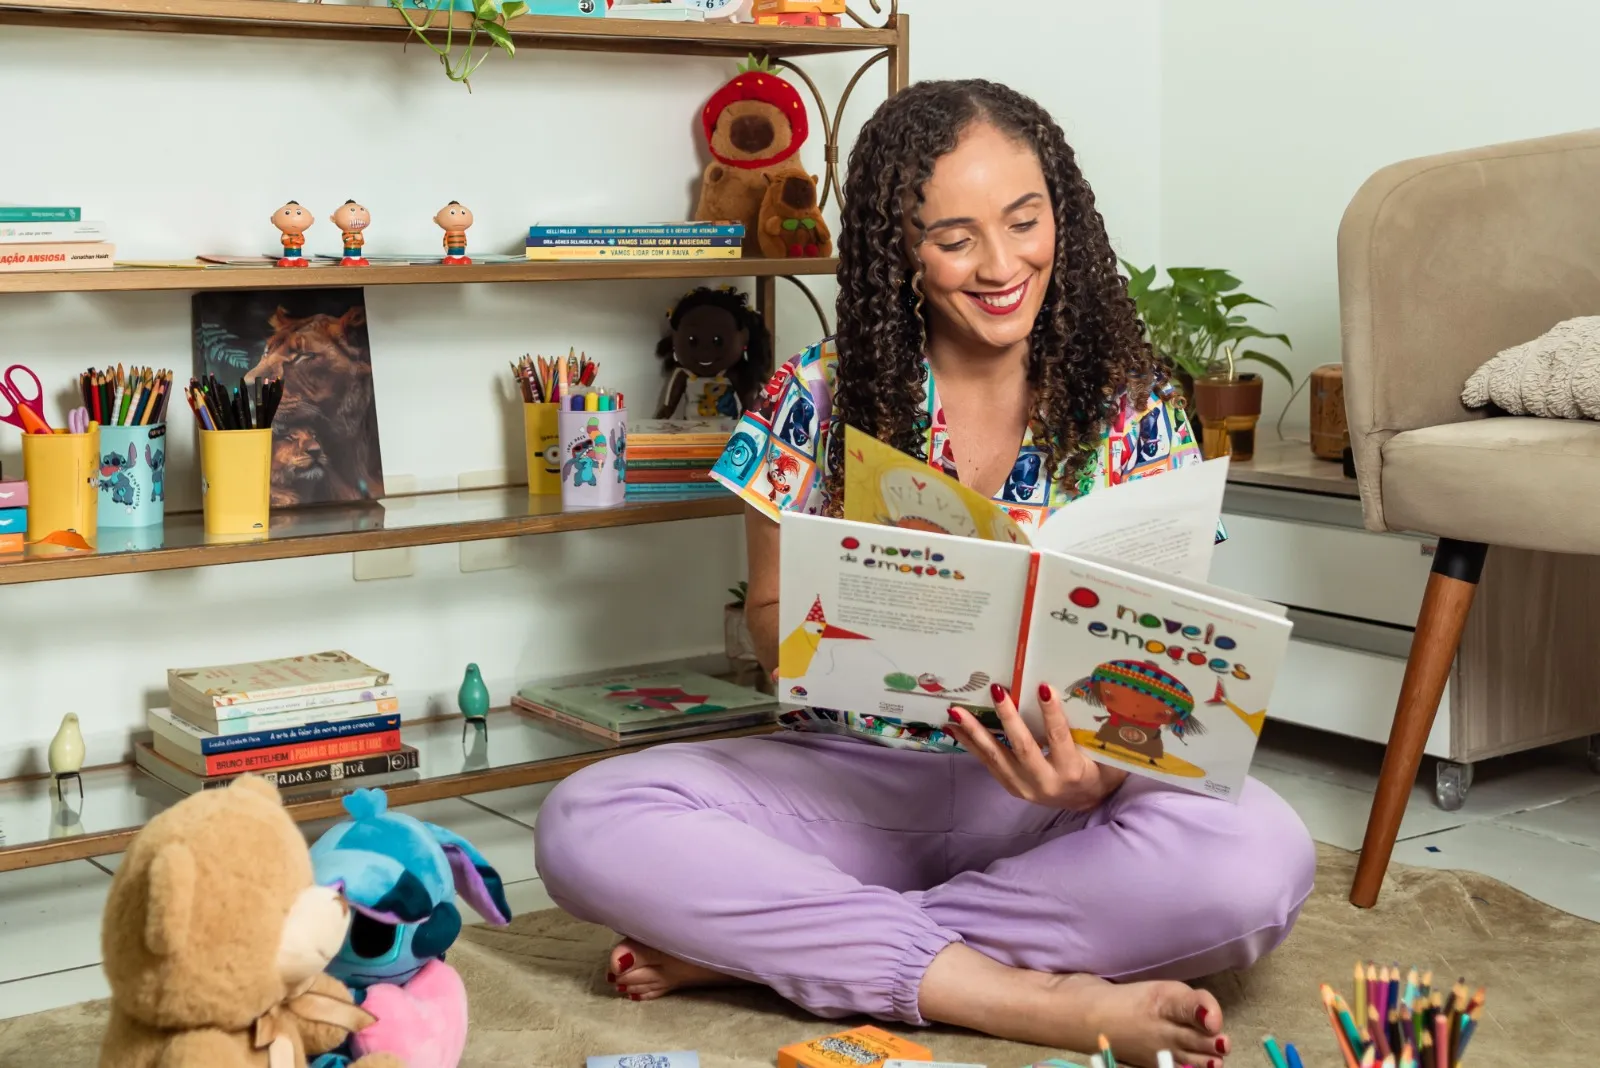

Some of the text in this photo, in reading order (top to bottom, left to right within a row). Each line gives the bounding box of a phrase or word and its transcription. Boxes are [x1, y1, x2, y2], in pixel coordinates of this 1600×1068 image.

[0, 253, 65, 265] AÇÃO ANSIOSA
[870, 543, 945, 562] novelo
[840, 553, 965, 580] de emoções
[1116, 604, 1237, 650] novelo
[1050, 608, 1251, 680] de emoções
[270, 732, 275, 740] A
[216, 752, 289, 770] BRUNO BETTELHEIM
[315, 769, 328, 779] NO
[332, 761, 365, 780] DIVÃ
